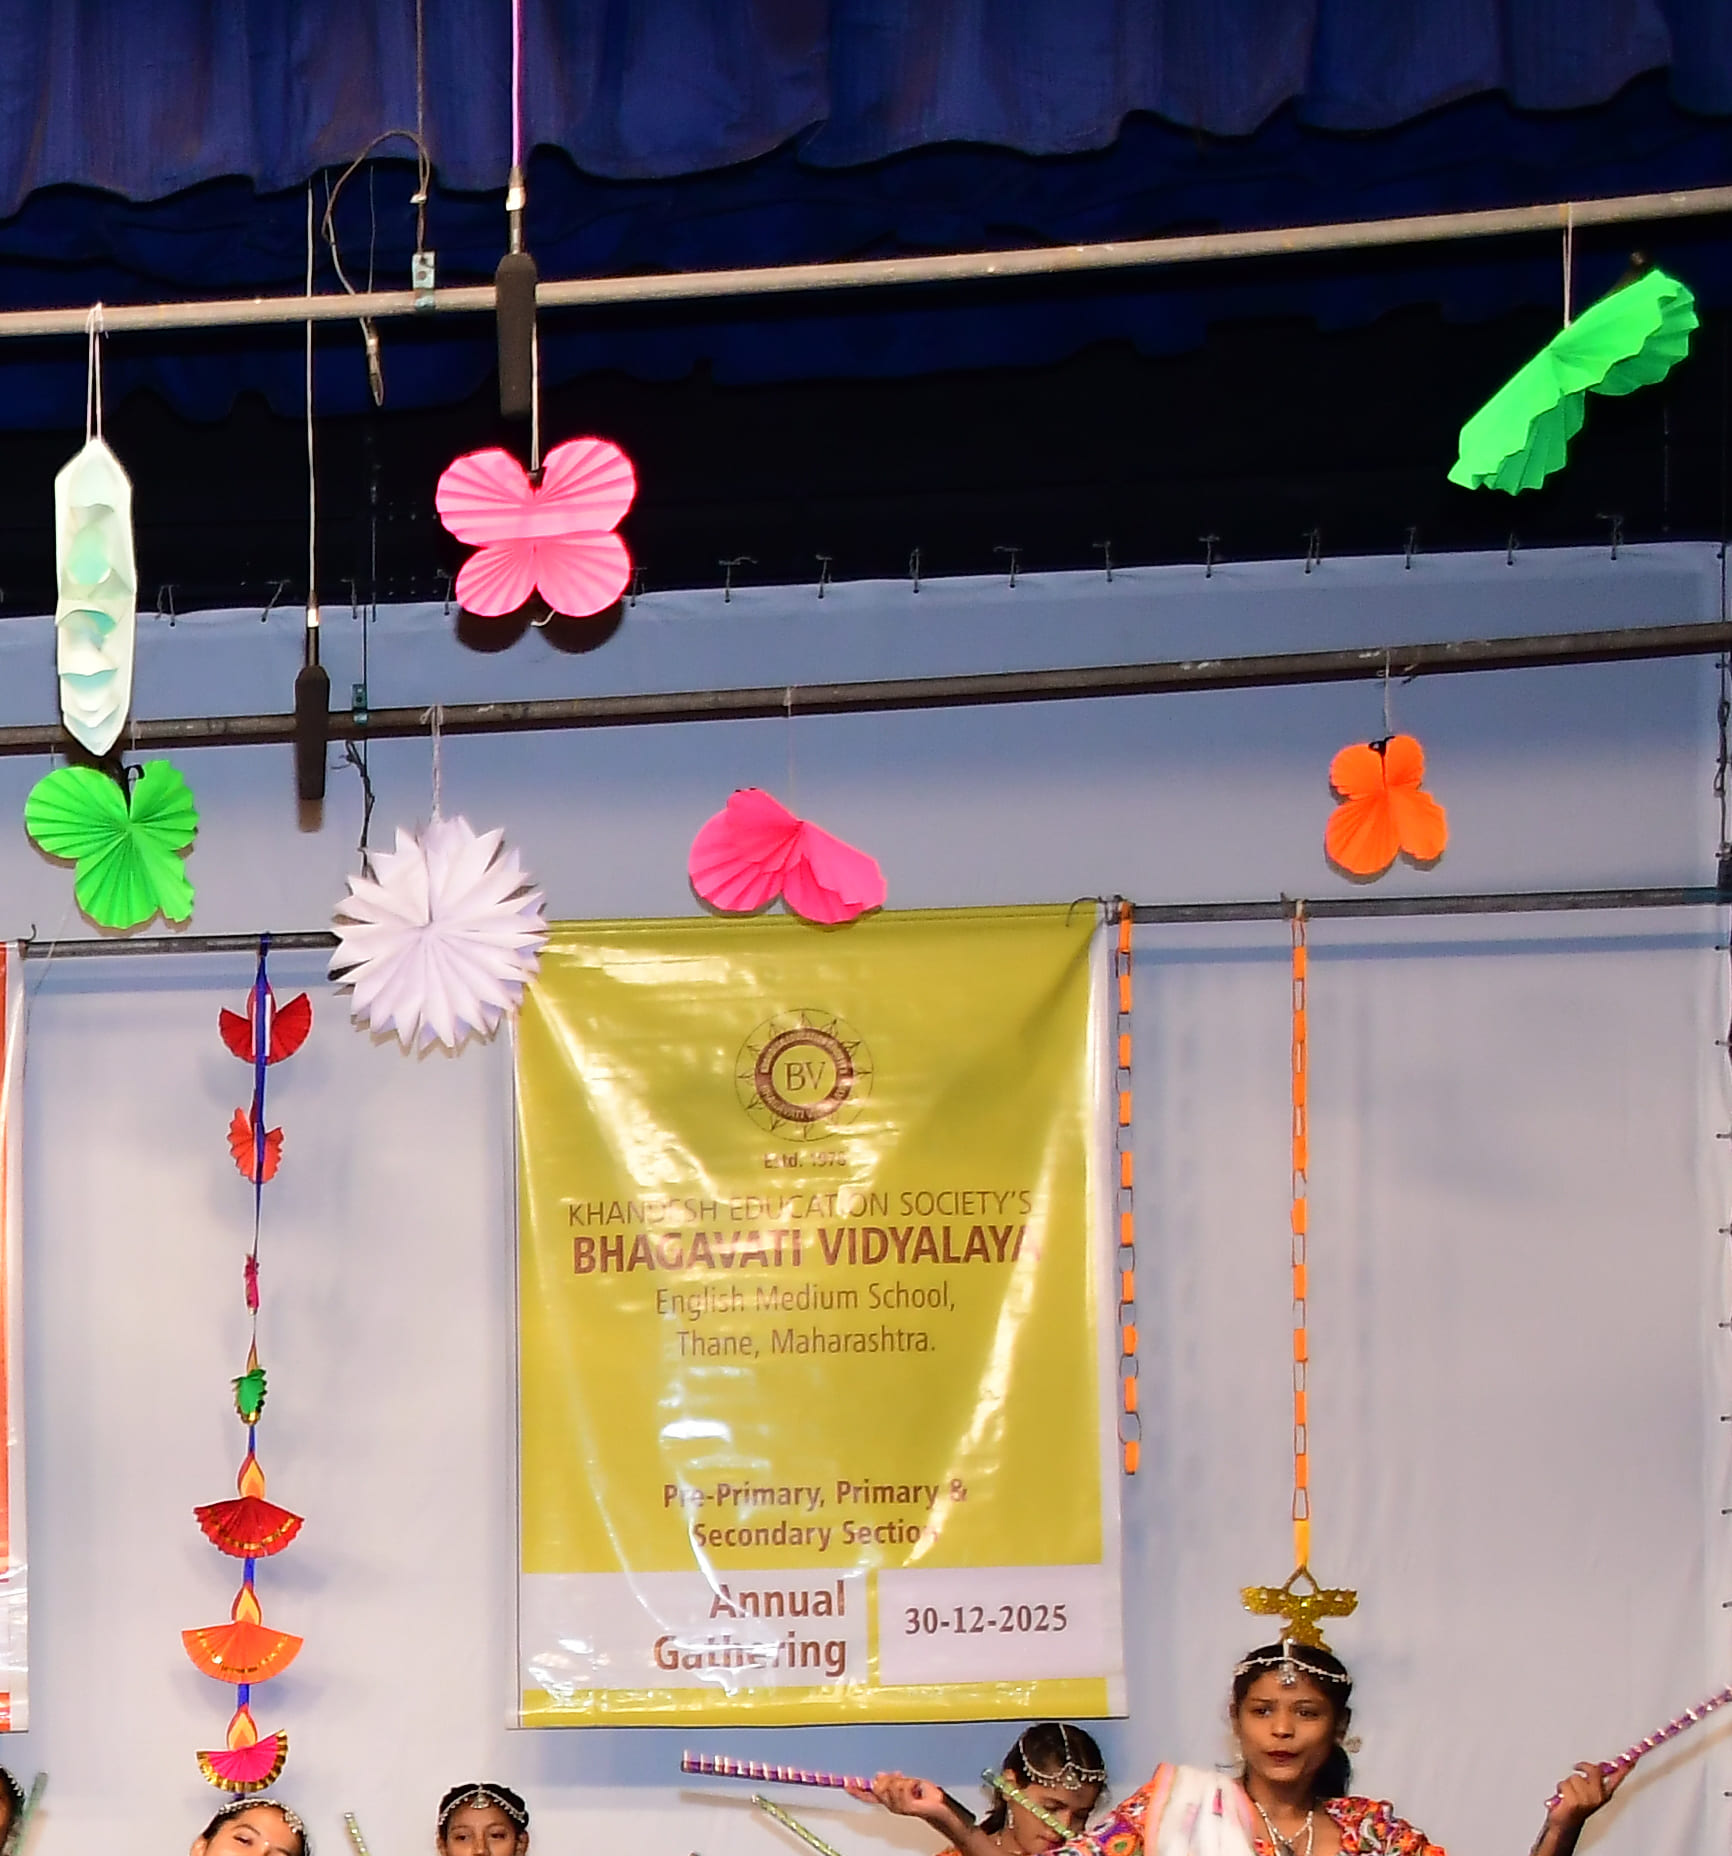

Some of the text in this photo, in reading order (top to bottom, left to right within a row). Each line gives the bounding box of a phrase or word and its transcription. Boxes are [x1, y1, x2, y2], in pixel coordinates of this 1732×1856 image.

[784, 1062, 826, 1091] BV
[574, 1229, 801, 1274] BHAGAVATI
[657, 1281, 955, 1321] English Medium School,
[677, 1325, 936, 1358] Thane, Maharashtra.
[664, 1481, 824, 1511] Pre-Primary,
[837, 1479, 939, 1510] Primary
[692, 1520, 831, 1551] Secondary
[710, 1580, 846, 1619] Annual
[905, 1604, 1067, 1635] 30-12-2025
